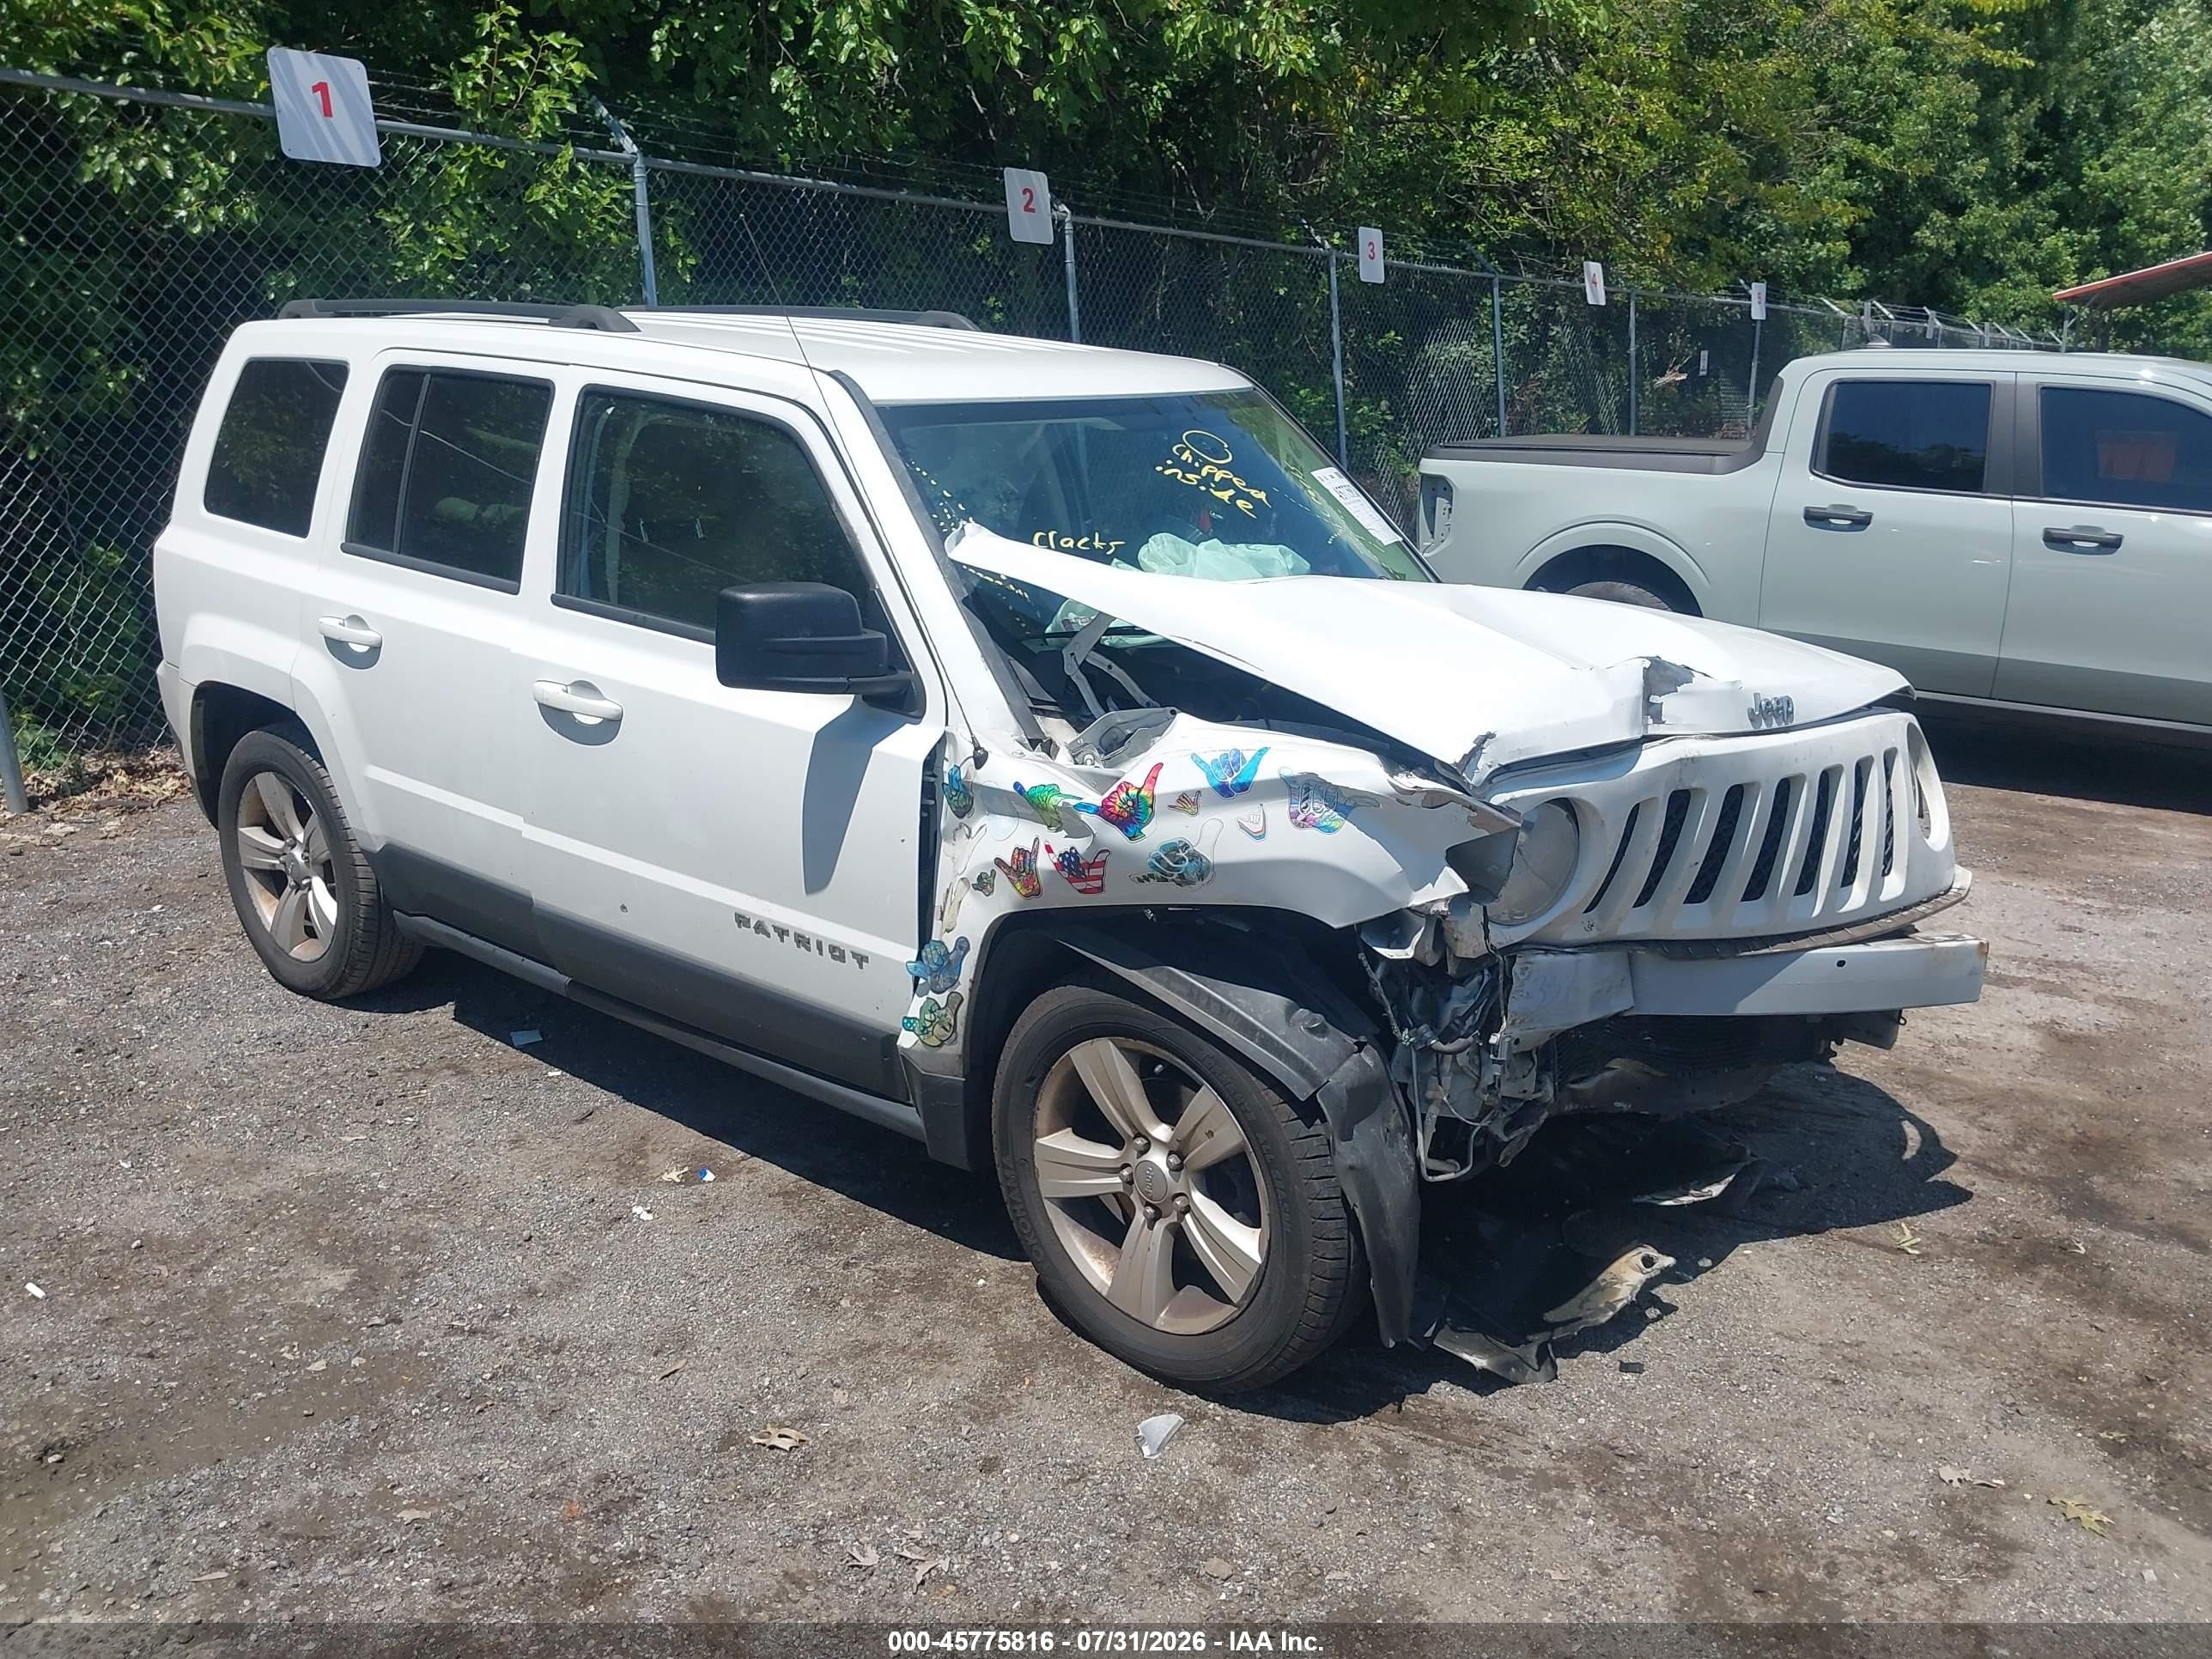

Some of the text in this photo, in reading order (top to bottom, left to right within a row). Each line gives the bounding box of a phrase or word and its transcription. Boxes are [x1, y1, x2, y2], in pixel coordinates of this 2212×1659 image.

[311, 81, 333, 118] 1
[1022, 187, 1036, 214] 2
[1368, 241, 1376, 261] 3
[1592, 272, 1598, 289] 4
[1747, 692, 1795, 728] Jeep
[734, 911, 870, 970] PATRIOT
